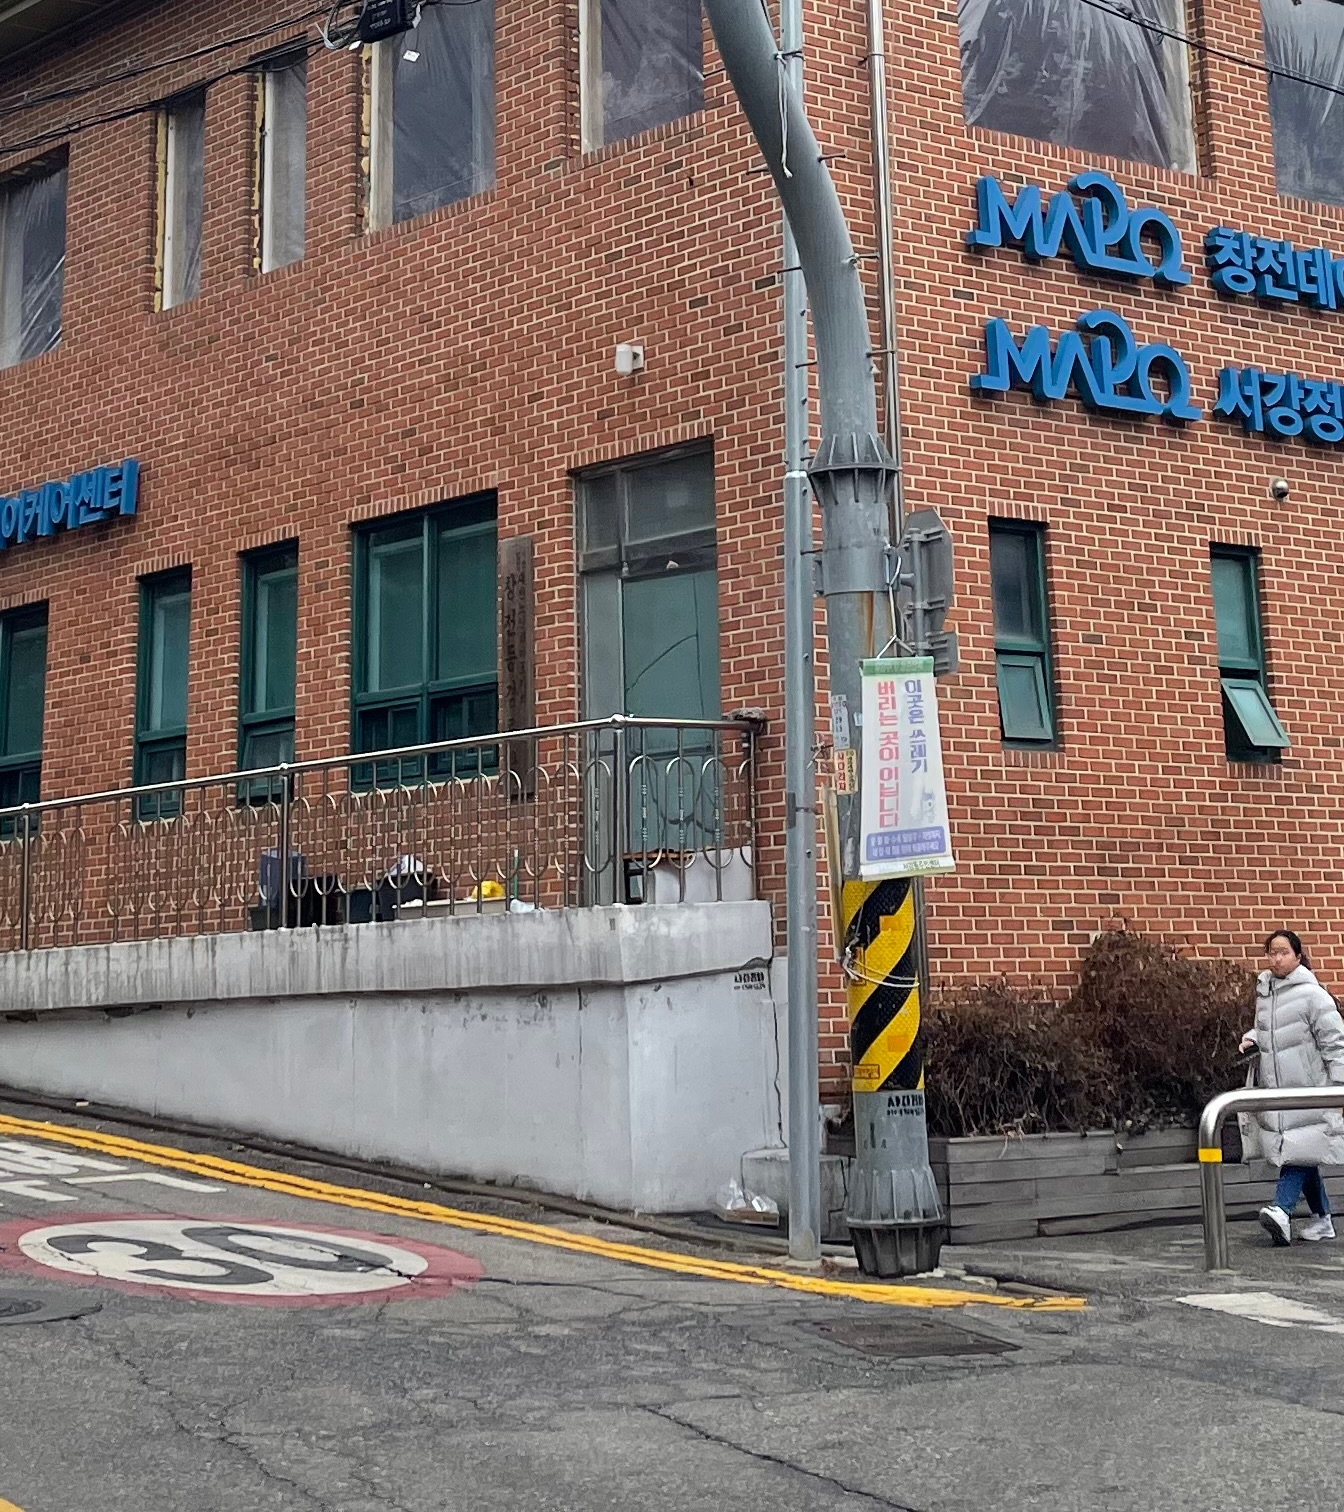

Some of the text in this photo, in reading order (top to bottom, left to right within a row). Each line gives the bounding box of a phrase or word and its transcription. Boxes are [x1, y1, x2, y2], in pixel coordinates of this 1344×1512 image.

[878, 680, 899, 727] 버리는
[904, 679, 928, 774] 이곳은 쓰레기
[879, 731, 900, 762] 곳이
[46, 1225, 393, 1285] 30
